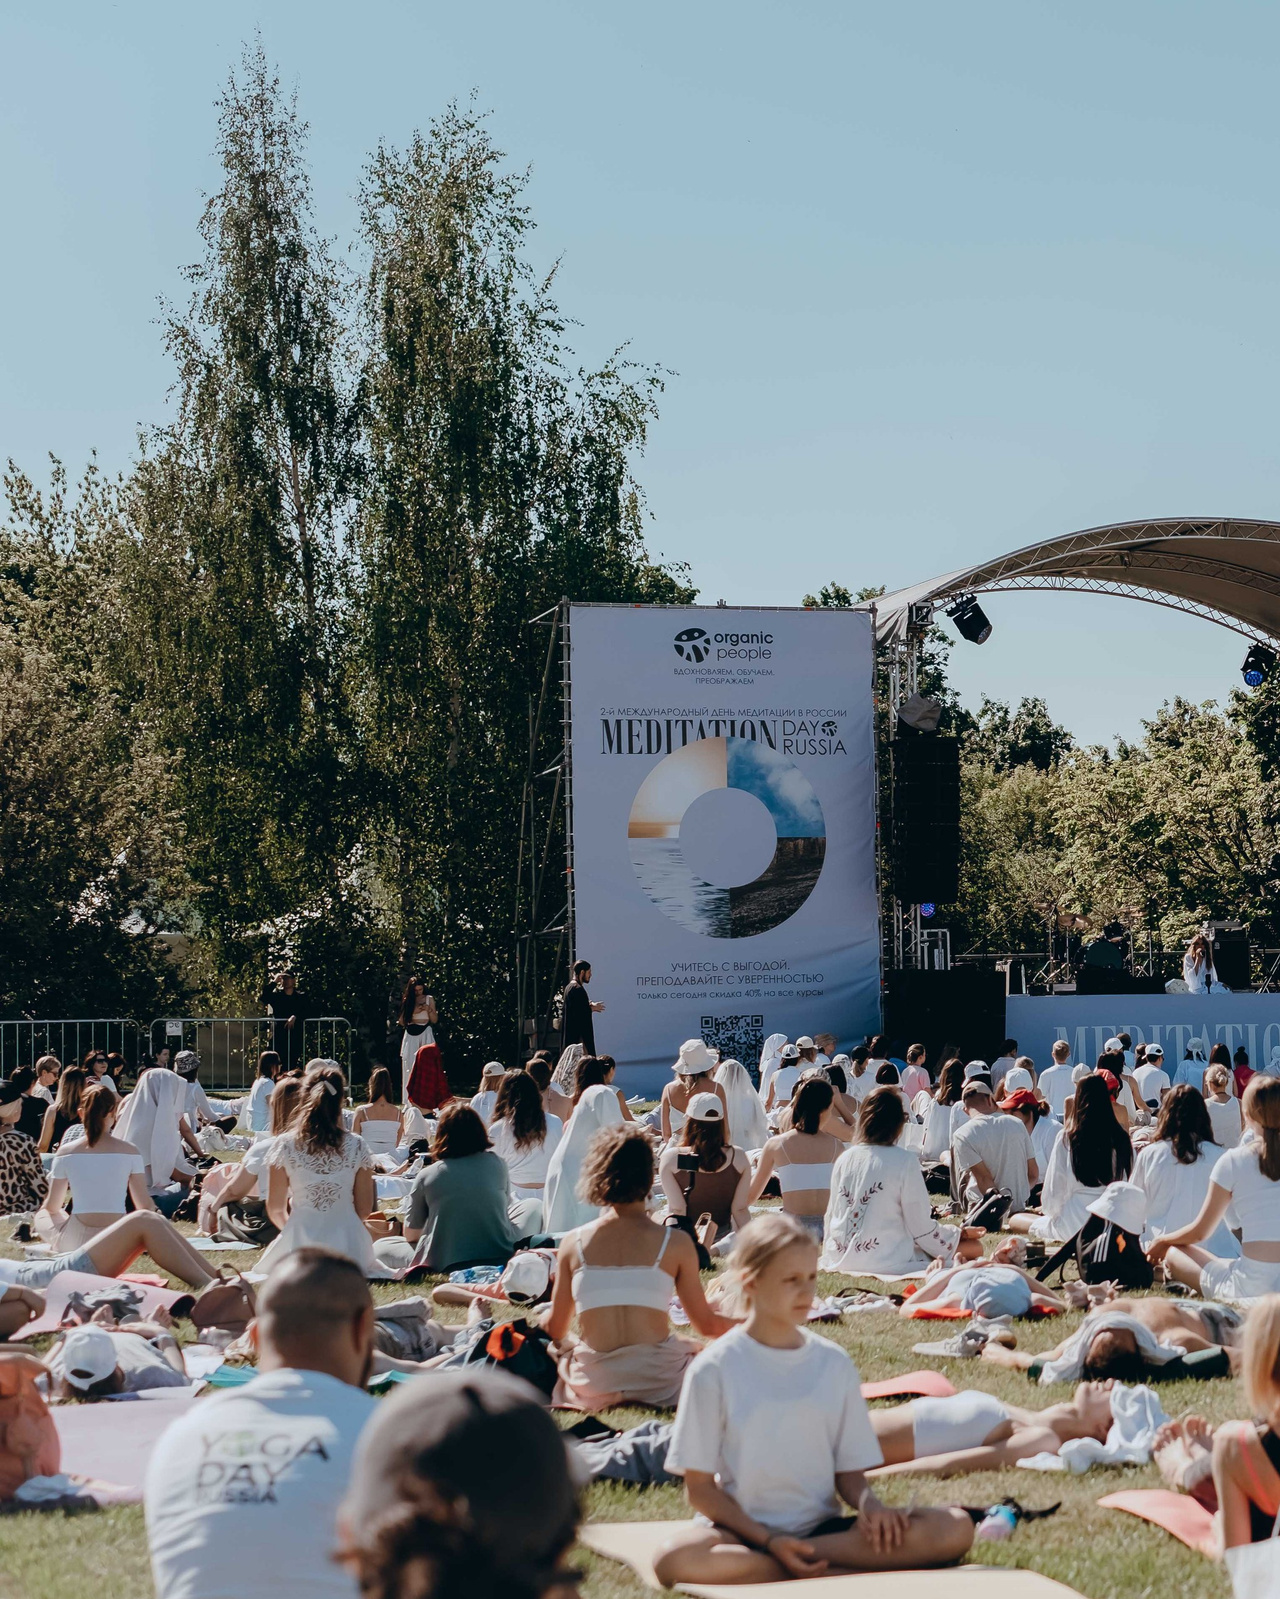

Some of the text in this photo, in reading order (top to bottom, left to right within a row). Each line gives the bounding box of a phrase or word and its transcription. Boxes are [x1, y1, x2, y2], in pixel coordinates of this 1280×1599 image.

[713, 630, 774, 647] organic
[717, 645, 772, 662] people
[695, 677, 755, 685] ПРЕОБРАЖАЕМ
[600, 706, 848, 718] 2-й МЕЖДУНАРОДНЫЙ ДЕНЬ МЕДИТАЦИИ В РОССИИ
[783, 720, 819, 736] DAY
[784, 739, 847, 755] RUSSIA
[671, 959, 791, 972] УЧИТЕСЬ С ВЫГОДОЙ.
[636, 973, 825, 986] ПРЕПОДАВАЙТЕ С УВЕРЕННОСТЬЮ
[709, 991, 742, 999] скидка
[744, 989, 762, 998] 40%
[797, 989, 824, 999] курсы
[197, 1461, 290, 1488] DAY
